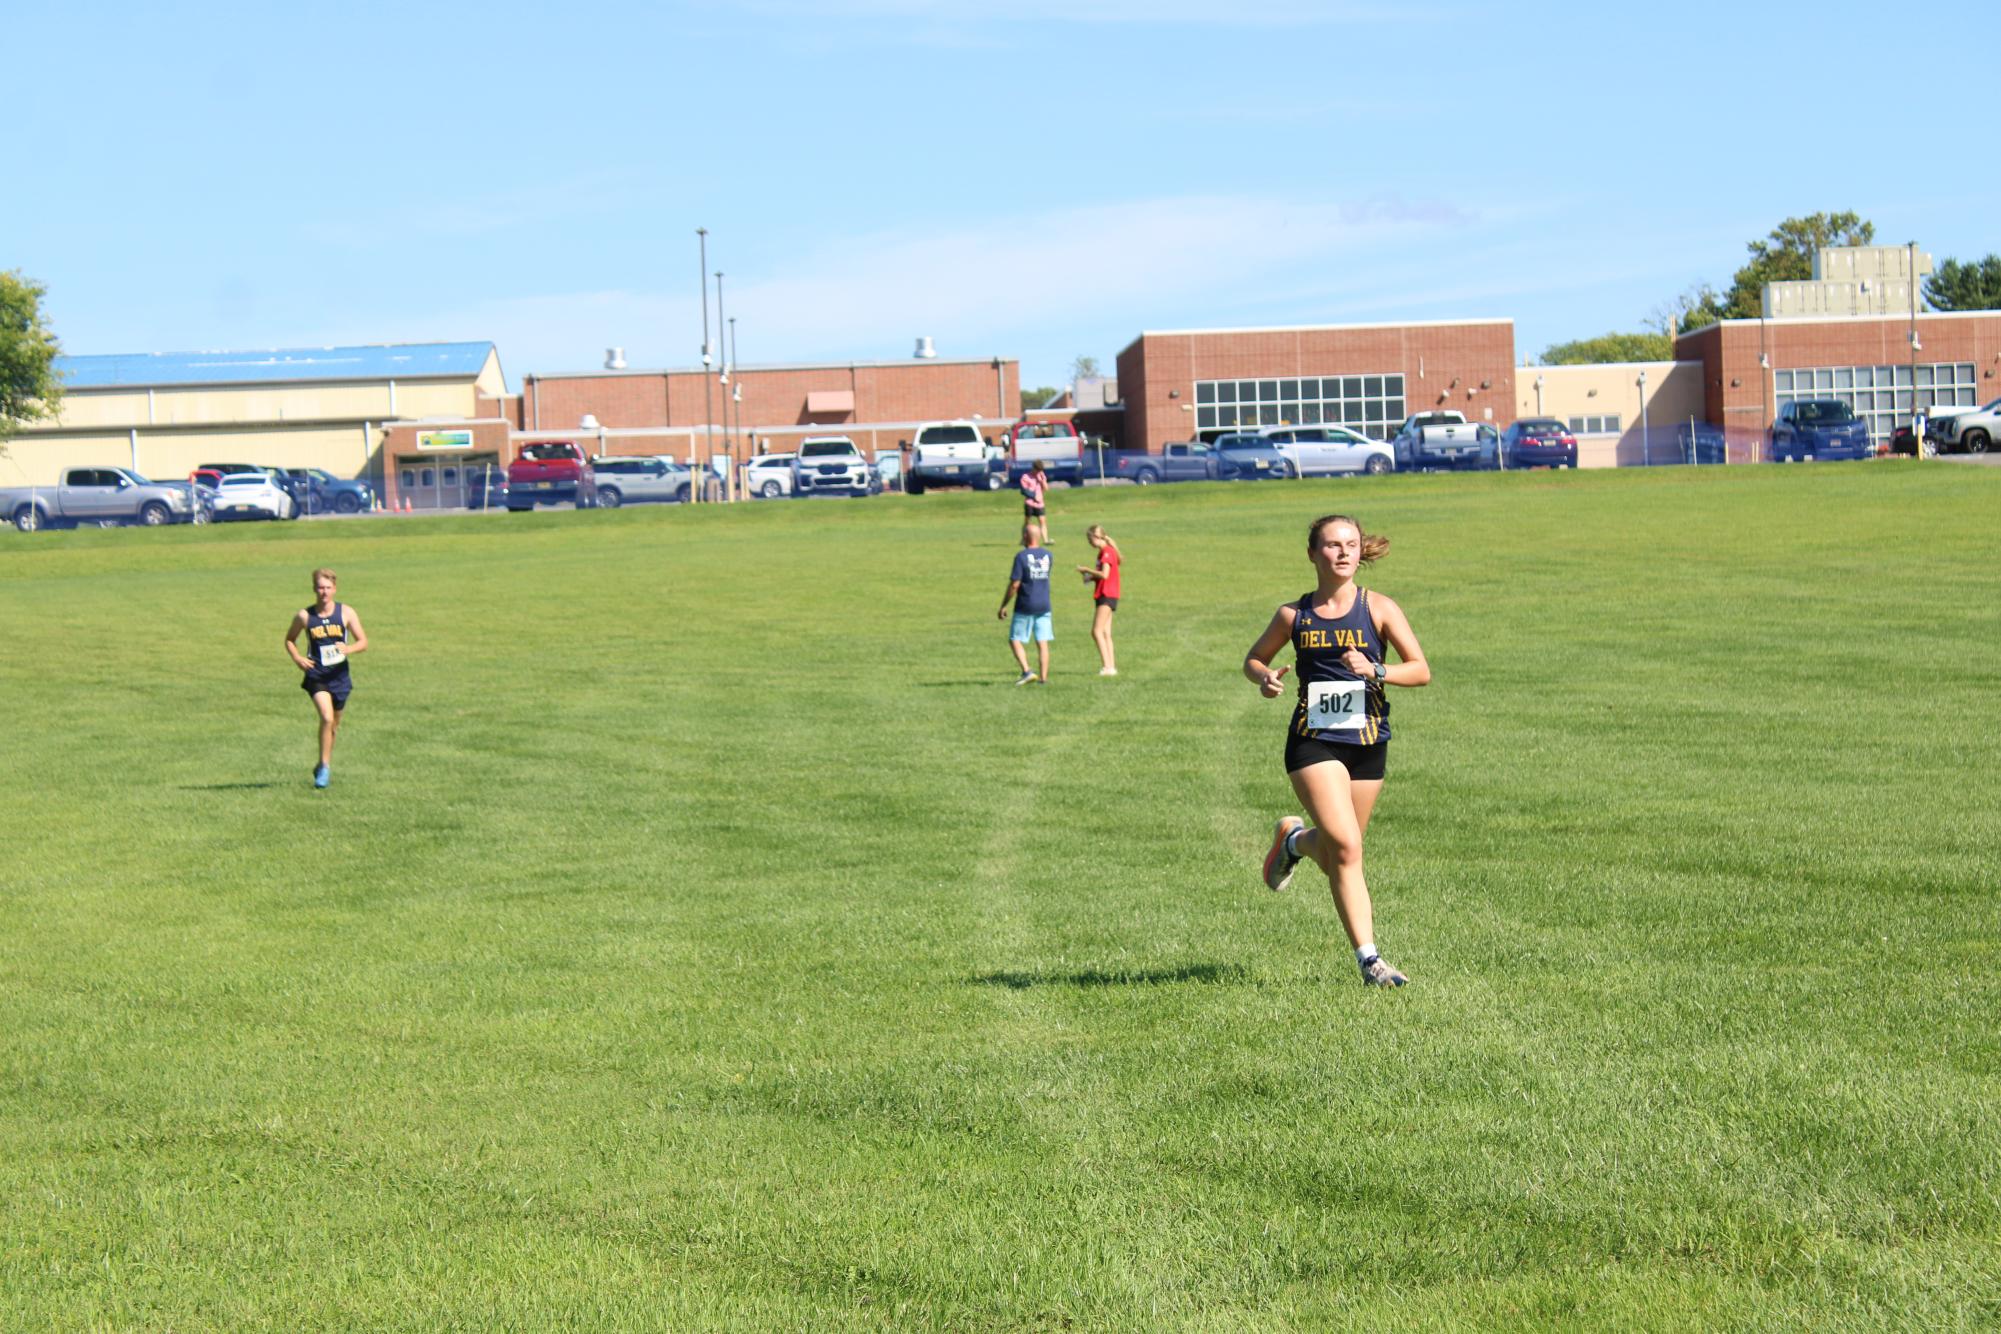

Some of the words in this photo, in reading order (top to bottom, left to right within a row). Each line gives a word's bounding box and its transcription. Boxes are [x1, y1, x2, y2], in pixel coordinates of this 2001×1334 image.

[1300, 630, 1332, 648] DEL
[1334, 629, 1368, 648] VAL
[1319, 692, 1353, 714] 502
